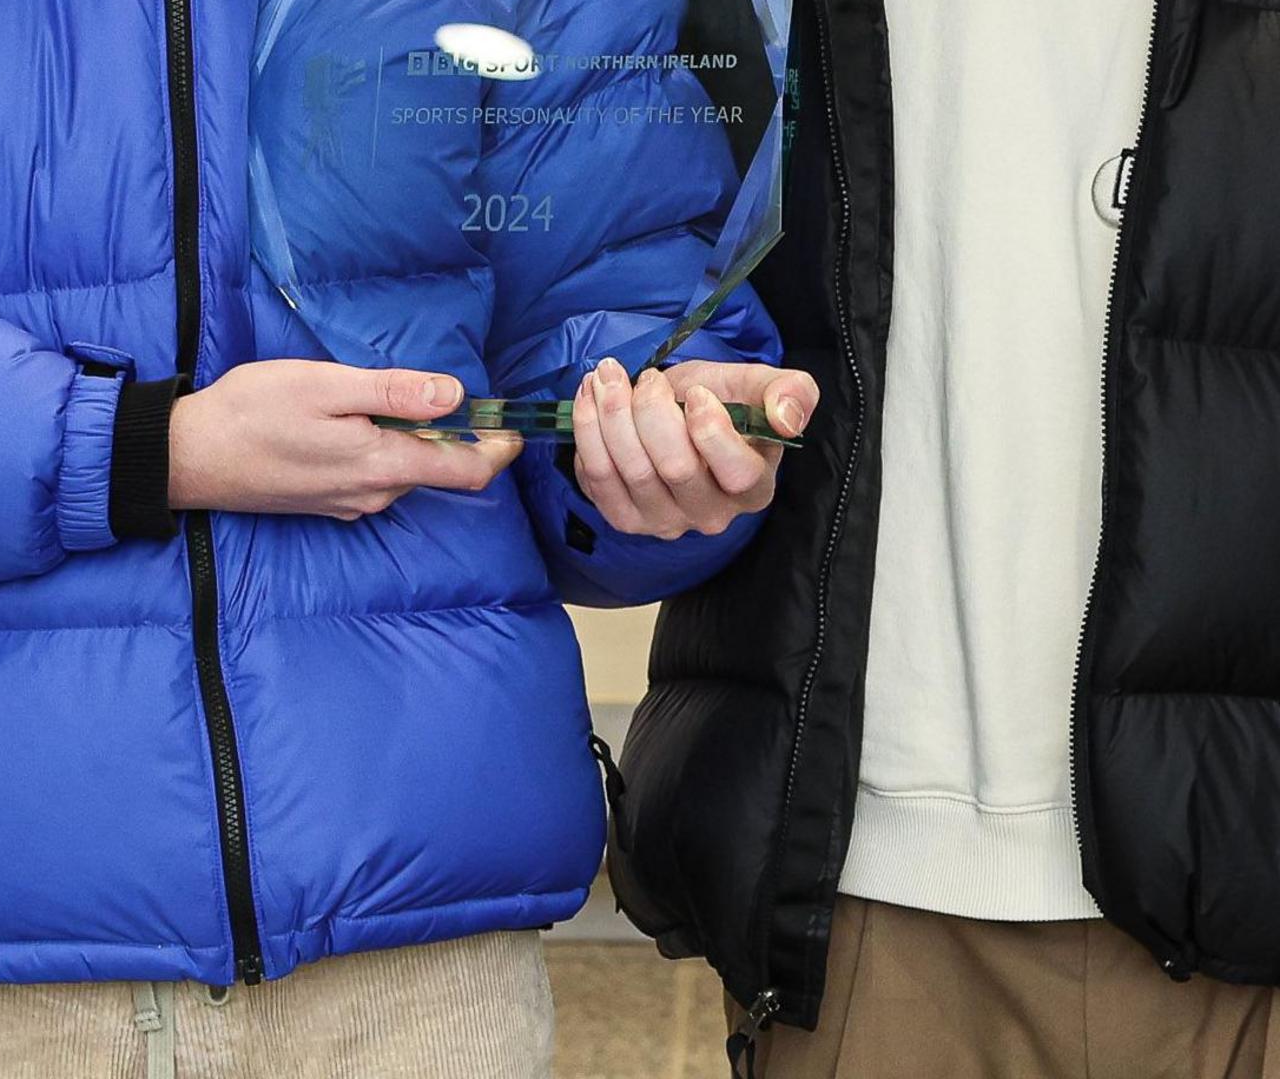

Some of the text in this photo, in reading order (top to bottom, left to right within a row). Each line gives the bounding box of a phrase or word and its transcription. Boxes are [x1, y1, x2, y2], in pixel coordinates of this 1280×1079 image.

[566, 54, 658, 71] NORTHERN
[662, 53, 738, 70] IRELAND
[391, 105, 744, 125] SPORTS PERSONALITY OF THE YEAR
[461, 193, 554, 232] 2024
